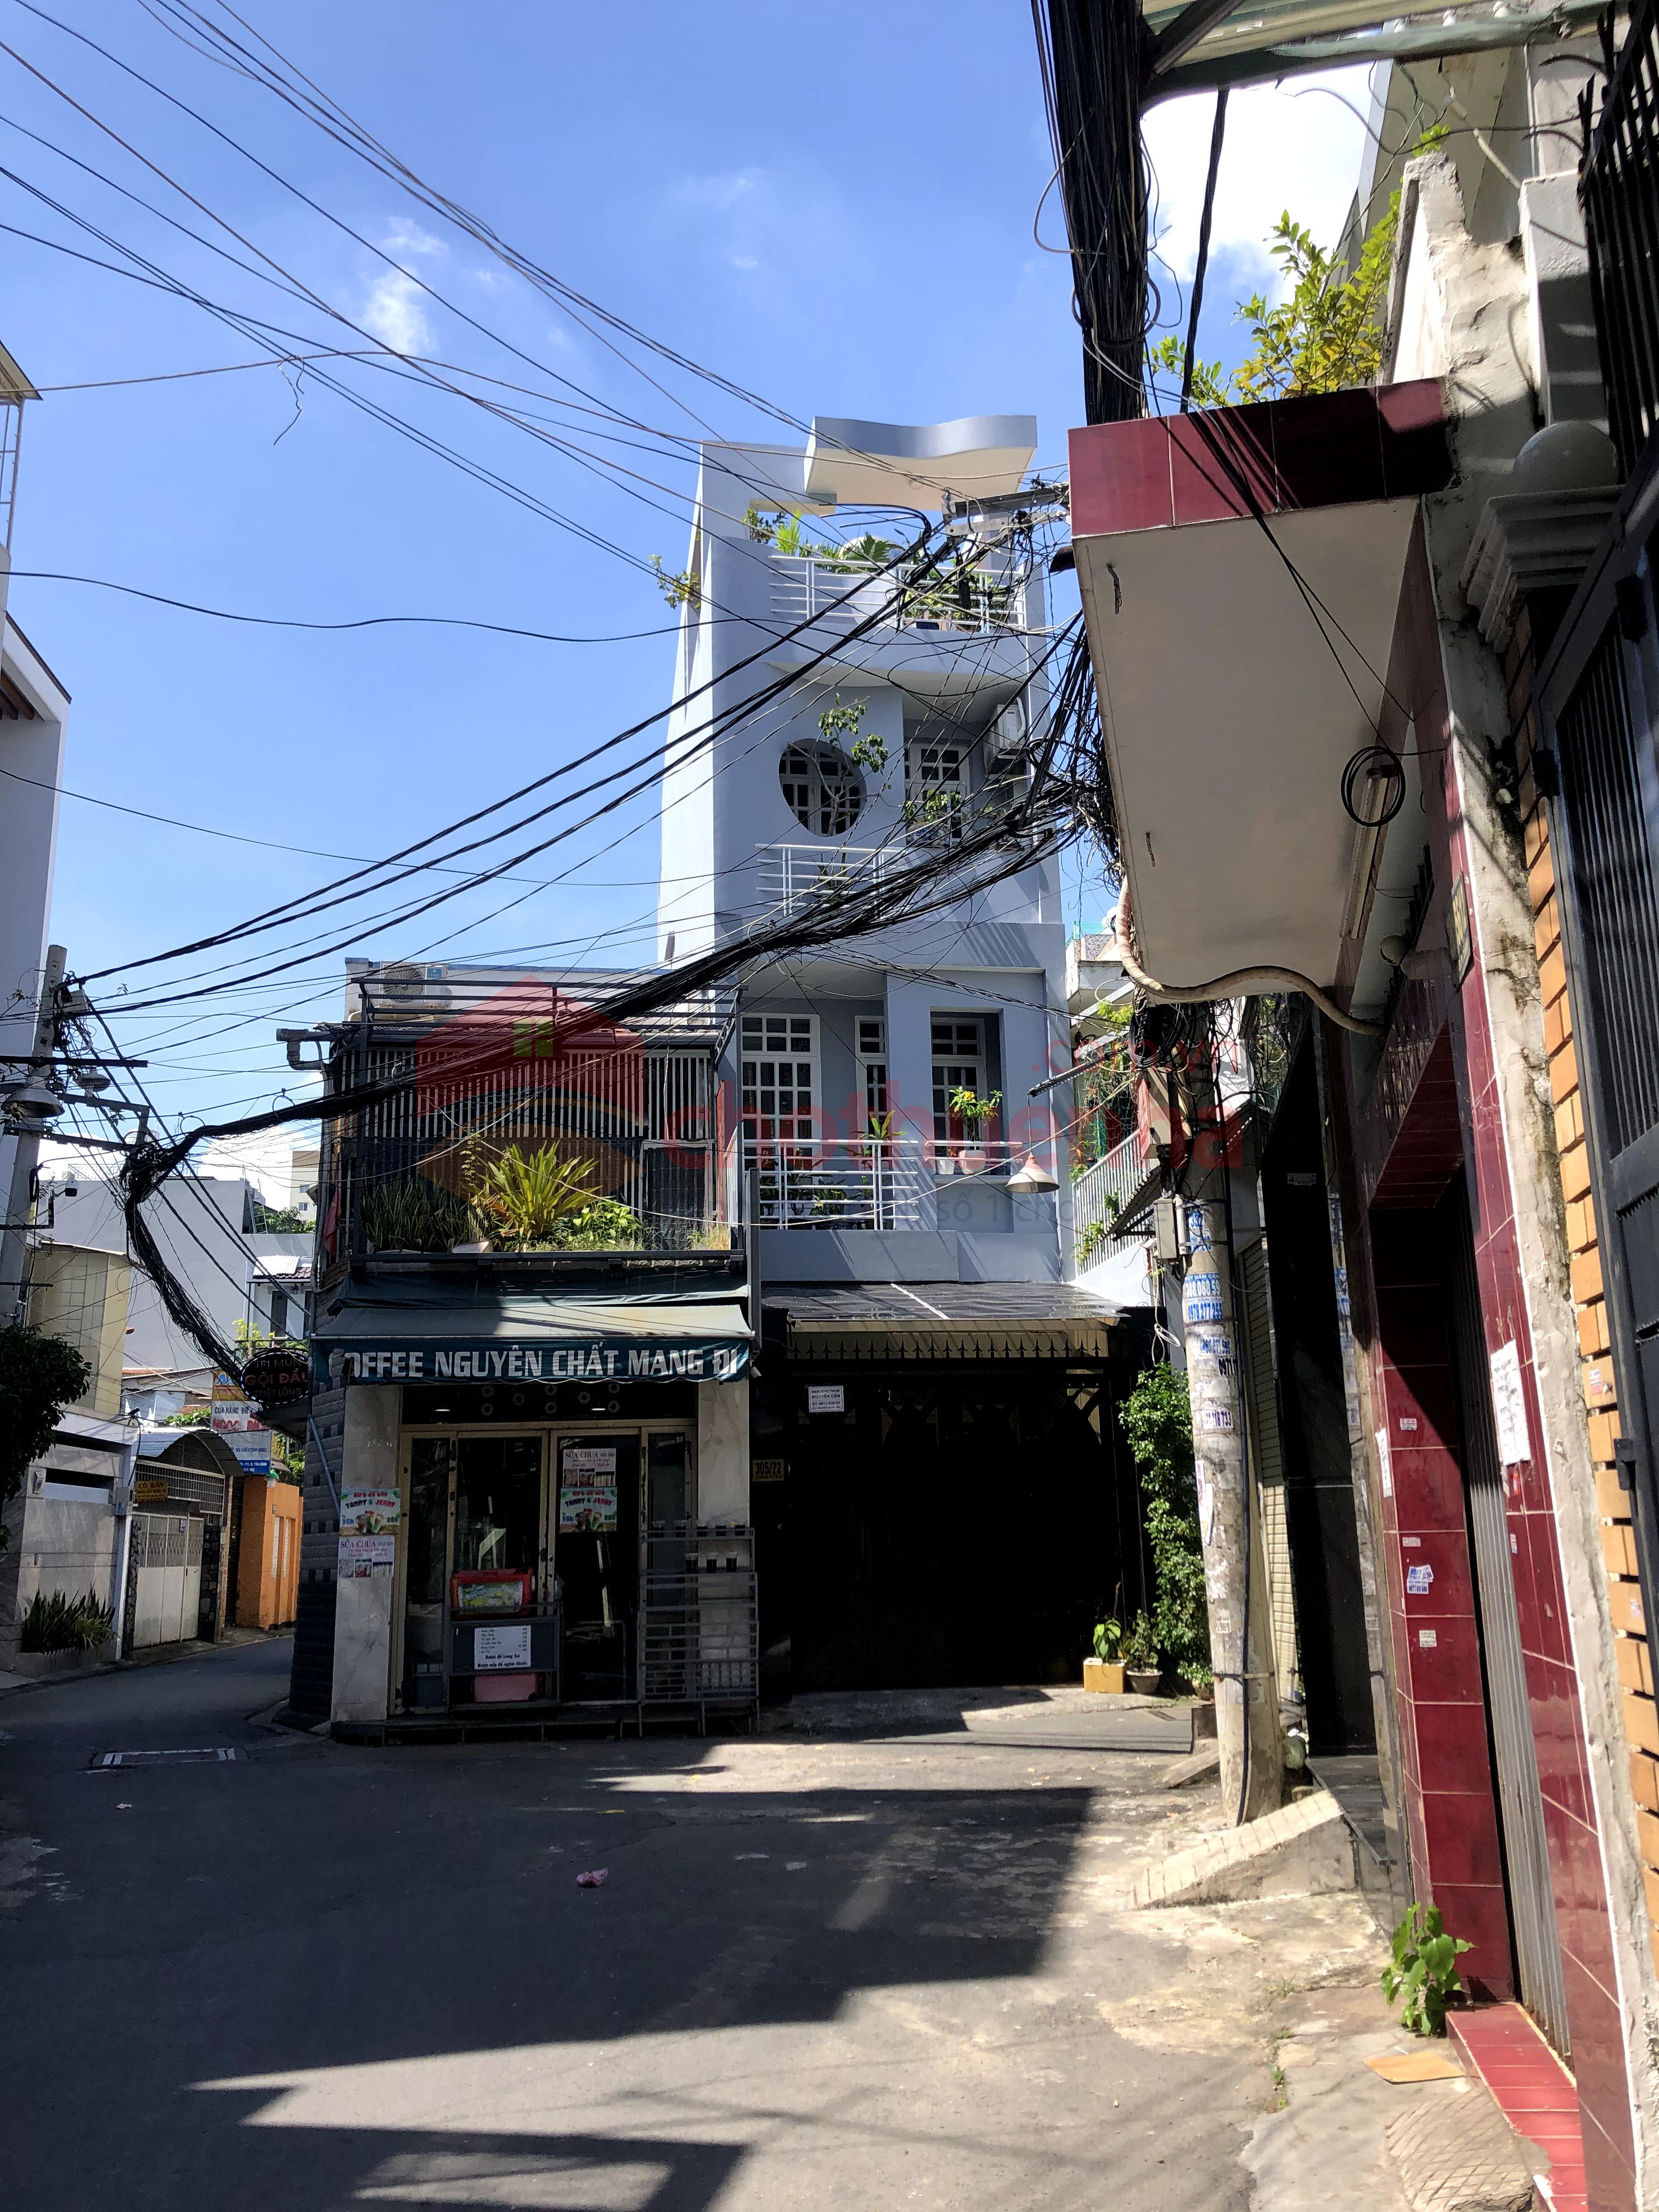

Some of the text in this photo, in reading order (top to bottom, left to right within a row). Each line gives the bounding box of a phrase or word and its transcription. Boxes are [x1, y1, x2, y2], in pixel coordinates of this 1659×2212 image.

[435, 1345, 542, 1377] NGUYÊN
[552, 1342, 618, 1375] CHẤT
[629, 1350, 703, 1375] MANG
[713, 1349, 737, 1374] ĐI
[245, 1372, 273, 1387] GỘI
[755, 1461, 782, 1475] 305/72
